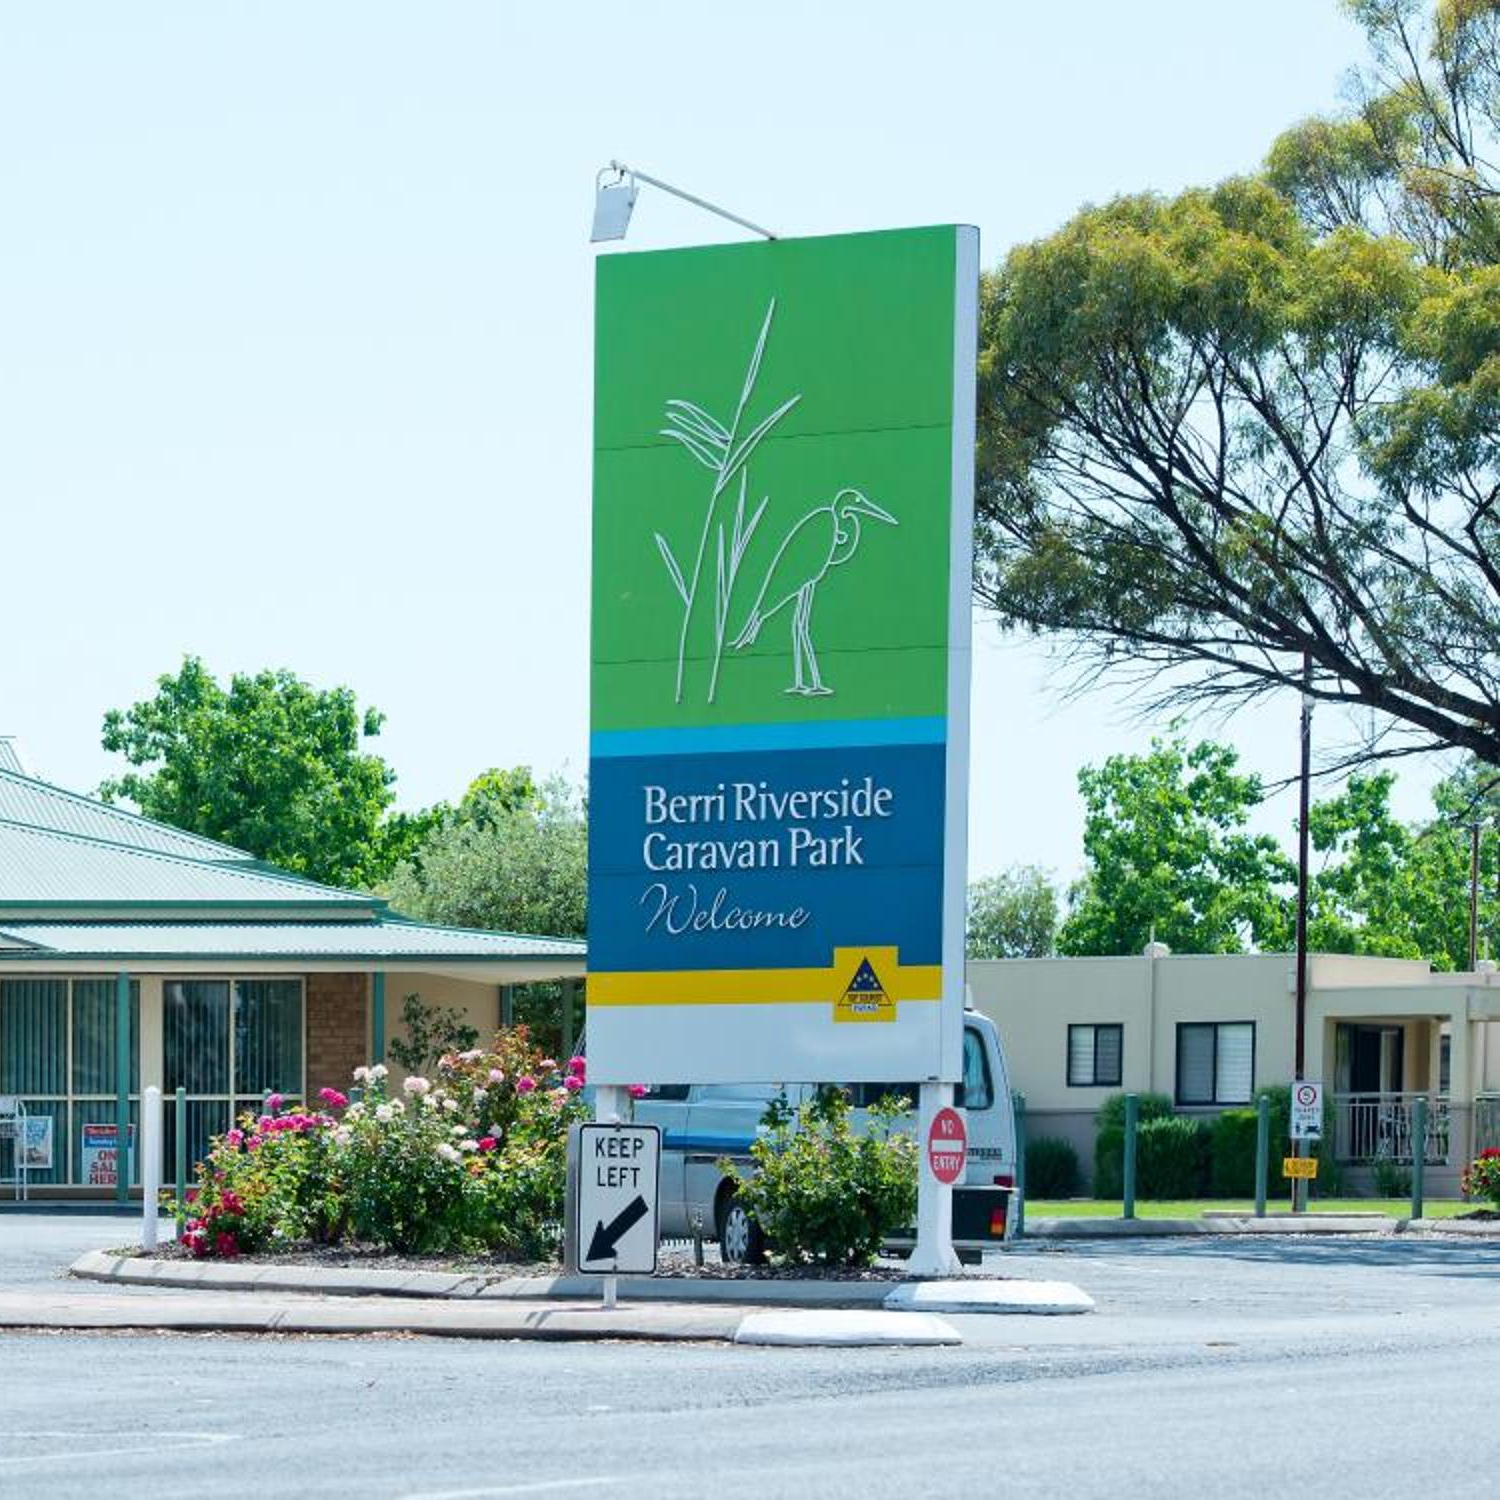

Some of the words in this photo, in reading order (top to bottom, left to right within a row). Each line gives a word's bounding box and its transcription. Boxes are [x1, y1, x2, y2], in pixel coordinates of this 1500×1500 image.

[644, 783, 725, 824] Berri
[732, 777, 893, 821] Riverside
[643, 832, 779, 871] Caravan
[788, 825, 865, 867] Park
[639, 883, 811, 934] Welcome
[941, 1119, 955, 1136] NO
[595, 1137, 645, 1158] KEEP
[91, 1161, 117, 1173] SAL
[933, 1155, 961, 1172] ENTRY
[89, 1173, 117, 1185] HER
[597, 1166, 641, 1188] LEFT
